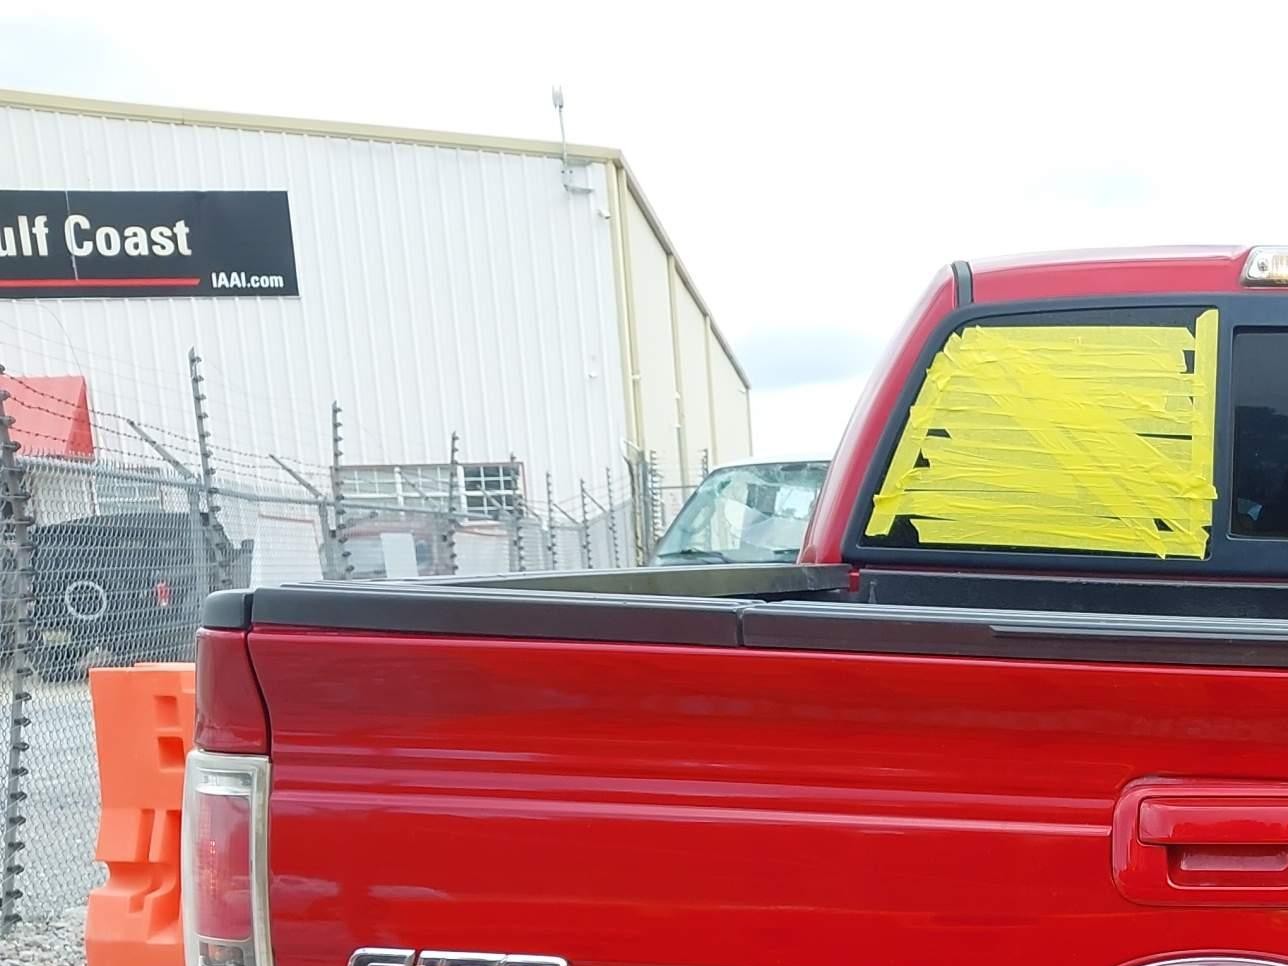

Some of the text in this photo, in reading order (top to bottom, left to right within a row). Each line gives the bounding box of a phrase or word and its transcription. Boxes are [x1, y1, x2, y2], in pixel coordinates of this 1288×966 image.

[0, 214, 192, 257] ulf Coast
[211, 271, 284, 289] IAAI.com
